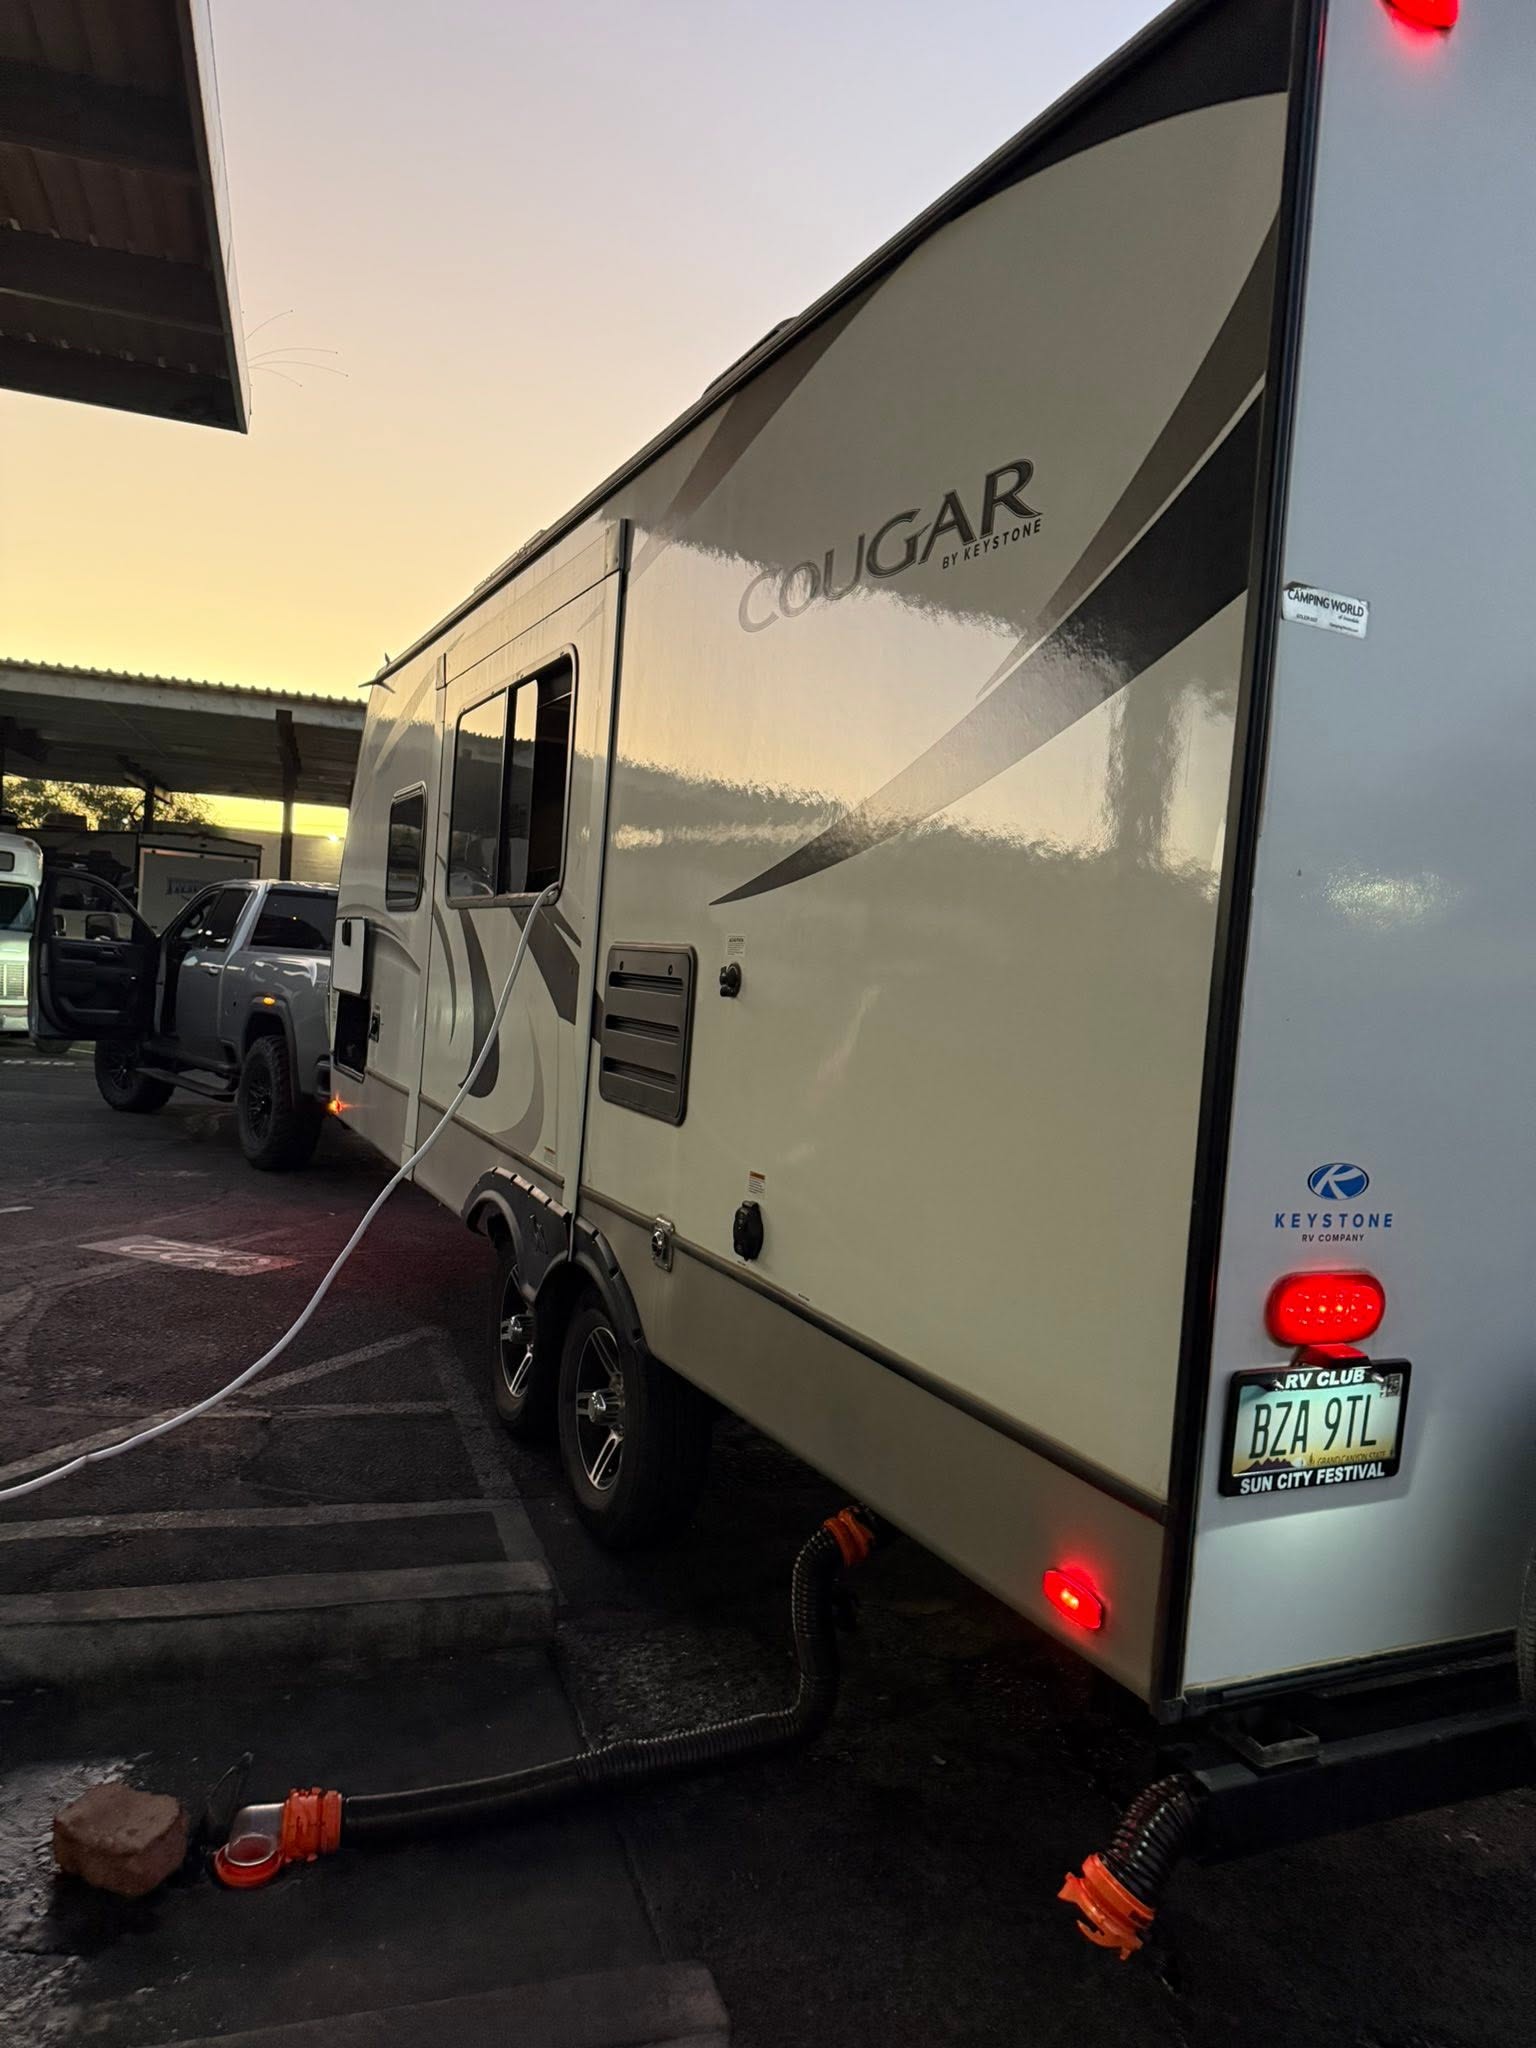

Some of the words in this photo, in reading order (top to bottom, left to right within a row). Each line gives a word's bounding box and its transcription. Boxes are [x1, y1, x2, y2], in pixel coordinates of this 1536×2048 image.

[738, 458, 1043, 633] COUGAR
[942, 552, 958, 569] BY
[964, 518, 1042, 560] KEYSTONE
[1287, 588, 1330, 609] CAMPING
[1331, 599, 1364, 617] WORLD
[1275, 1212, 1393, 1228] KEYSTONE
[1302, 1233, 1315, 1242] RV
[1318, 1233, 1365, 1242] COMPANY
[1285, 1373, 1313, 1389] RV
[1316, 1369, 1366, 1387] CLUB
[1249, 1399, 1311, 1460] BZA
[1323, 1394, 1377, 1451] 9TL
[1240, 1477, 1273, 1495] SUN
[1277, 1470, 1312, 1488] CITY
[1316, 1462, 1385, 1483] FESTIVAL
